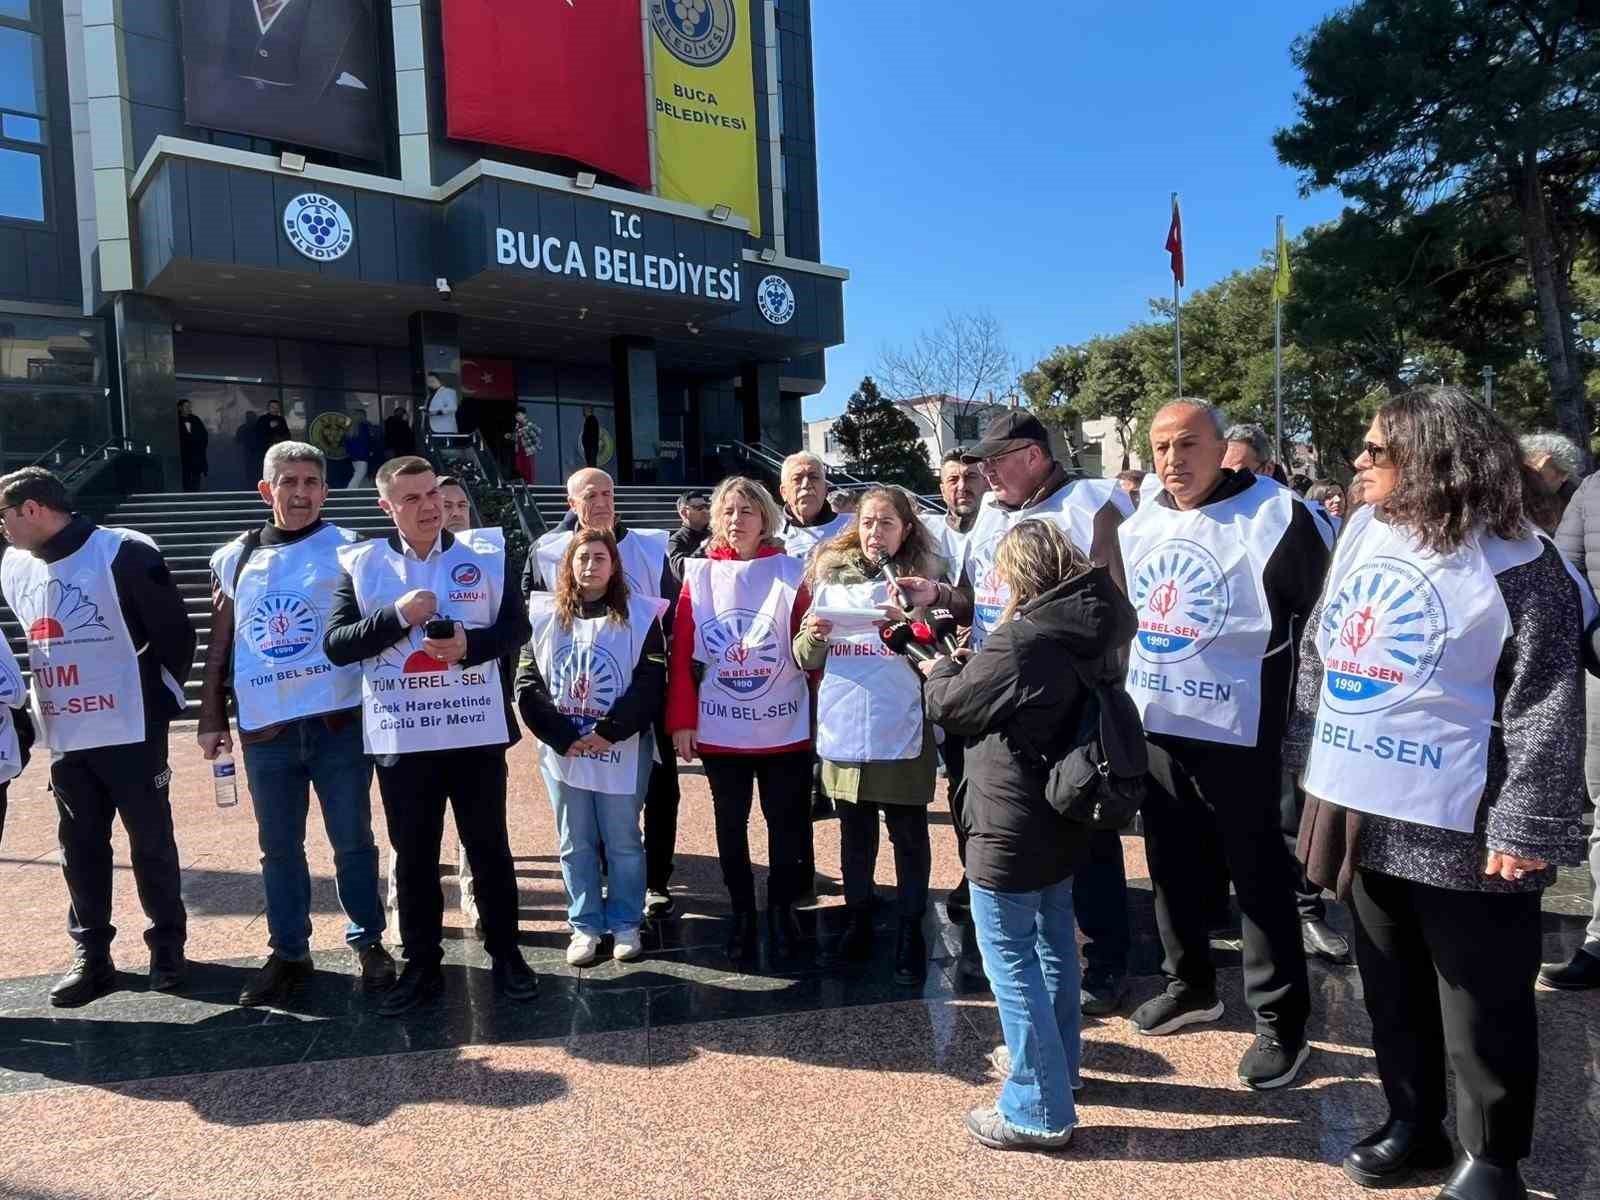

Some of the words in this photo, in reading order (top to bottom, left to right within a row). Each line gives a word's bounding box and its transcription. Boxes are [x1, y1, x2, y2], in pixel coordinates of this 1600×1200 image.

[673, 83, 719, 106] BUCA
[656, 98, 747, 130] BELEDİYESİ
[297, 195, 337, 213] BUCA
[610, 210, 641, 239] T.C
[496, 227, 587, 278] BUCA
[594, 245, 740, 301] BELEDİYESİ
[1151, 622, 1199, 638] BEL-SEN
[1146, 635, 1170, 648] 1990
[33, 662, 79, 688] TÜM
[372, 677, 396, 692] TÜM
[397, 674, 451, 690] YEREL
[462, 673, 486, 686] SEN
[1341, 661, 1403, 684] BEL-SEN
[1141, 672, 1231, 702] BEL-SEN
[1334, 676, 1362, 693] 1990
[406, 695, 492, 713] Hareketinde
[700, 699, 728, 717] TÜM
[731, 701, 799, 721] BEL-SEN
[420, 715, 442, 728] Bir
[447, 711, 486, 725] Mevzi
[1321, 722, 1444, 770] BEL-SEN
